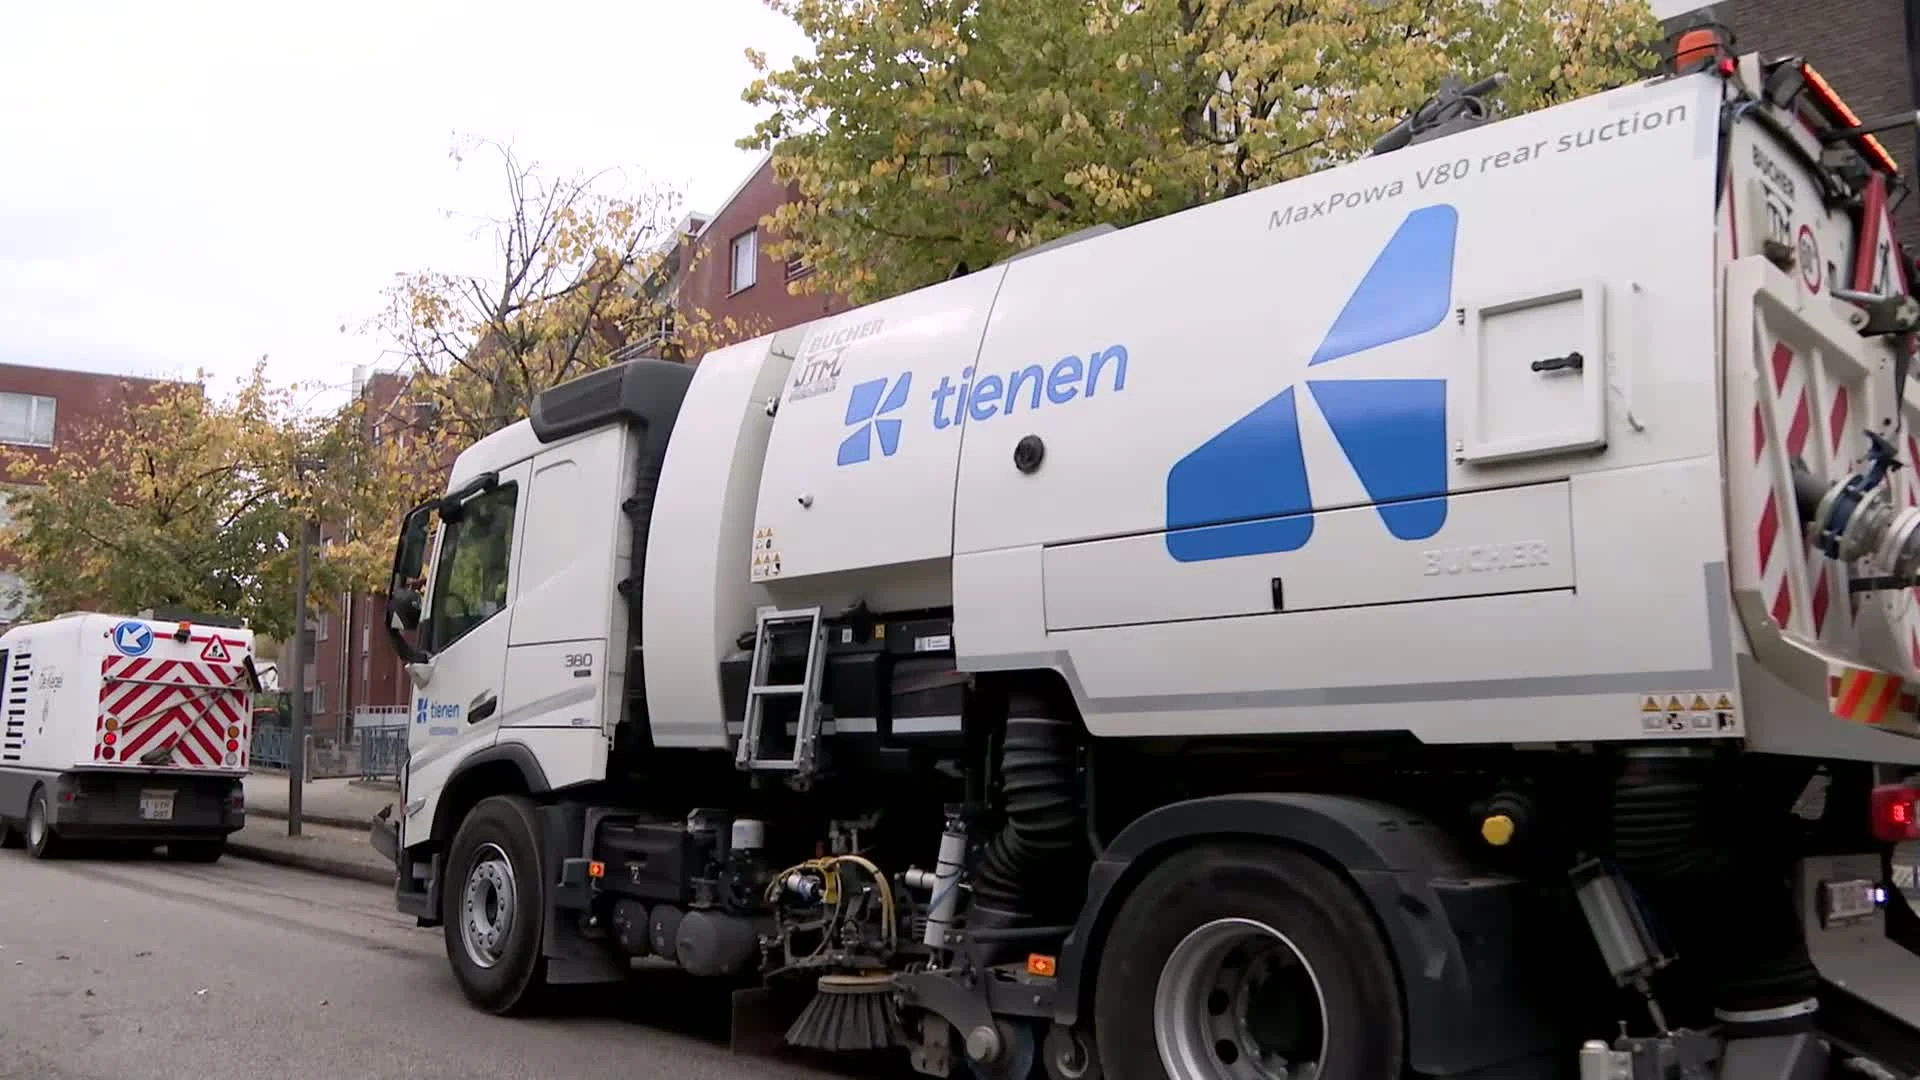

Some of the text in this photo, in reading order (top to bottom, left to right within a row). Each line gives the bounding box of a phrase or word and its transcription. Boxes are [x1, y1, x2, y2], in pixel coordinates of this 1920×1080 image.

[1268, 104, 1687, 231] MaxPowa V80 rear suction
[809, 319, 885, 352] BUCHER
[931, 344, 1129, 430] tienen
[1423, 541, 1549, 576] BUCHER
[565, 653, 593, 668] 380
[430, 700, 460, 719] tienen
